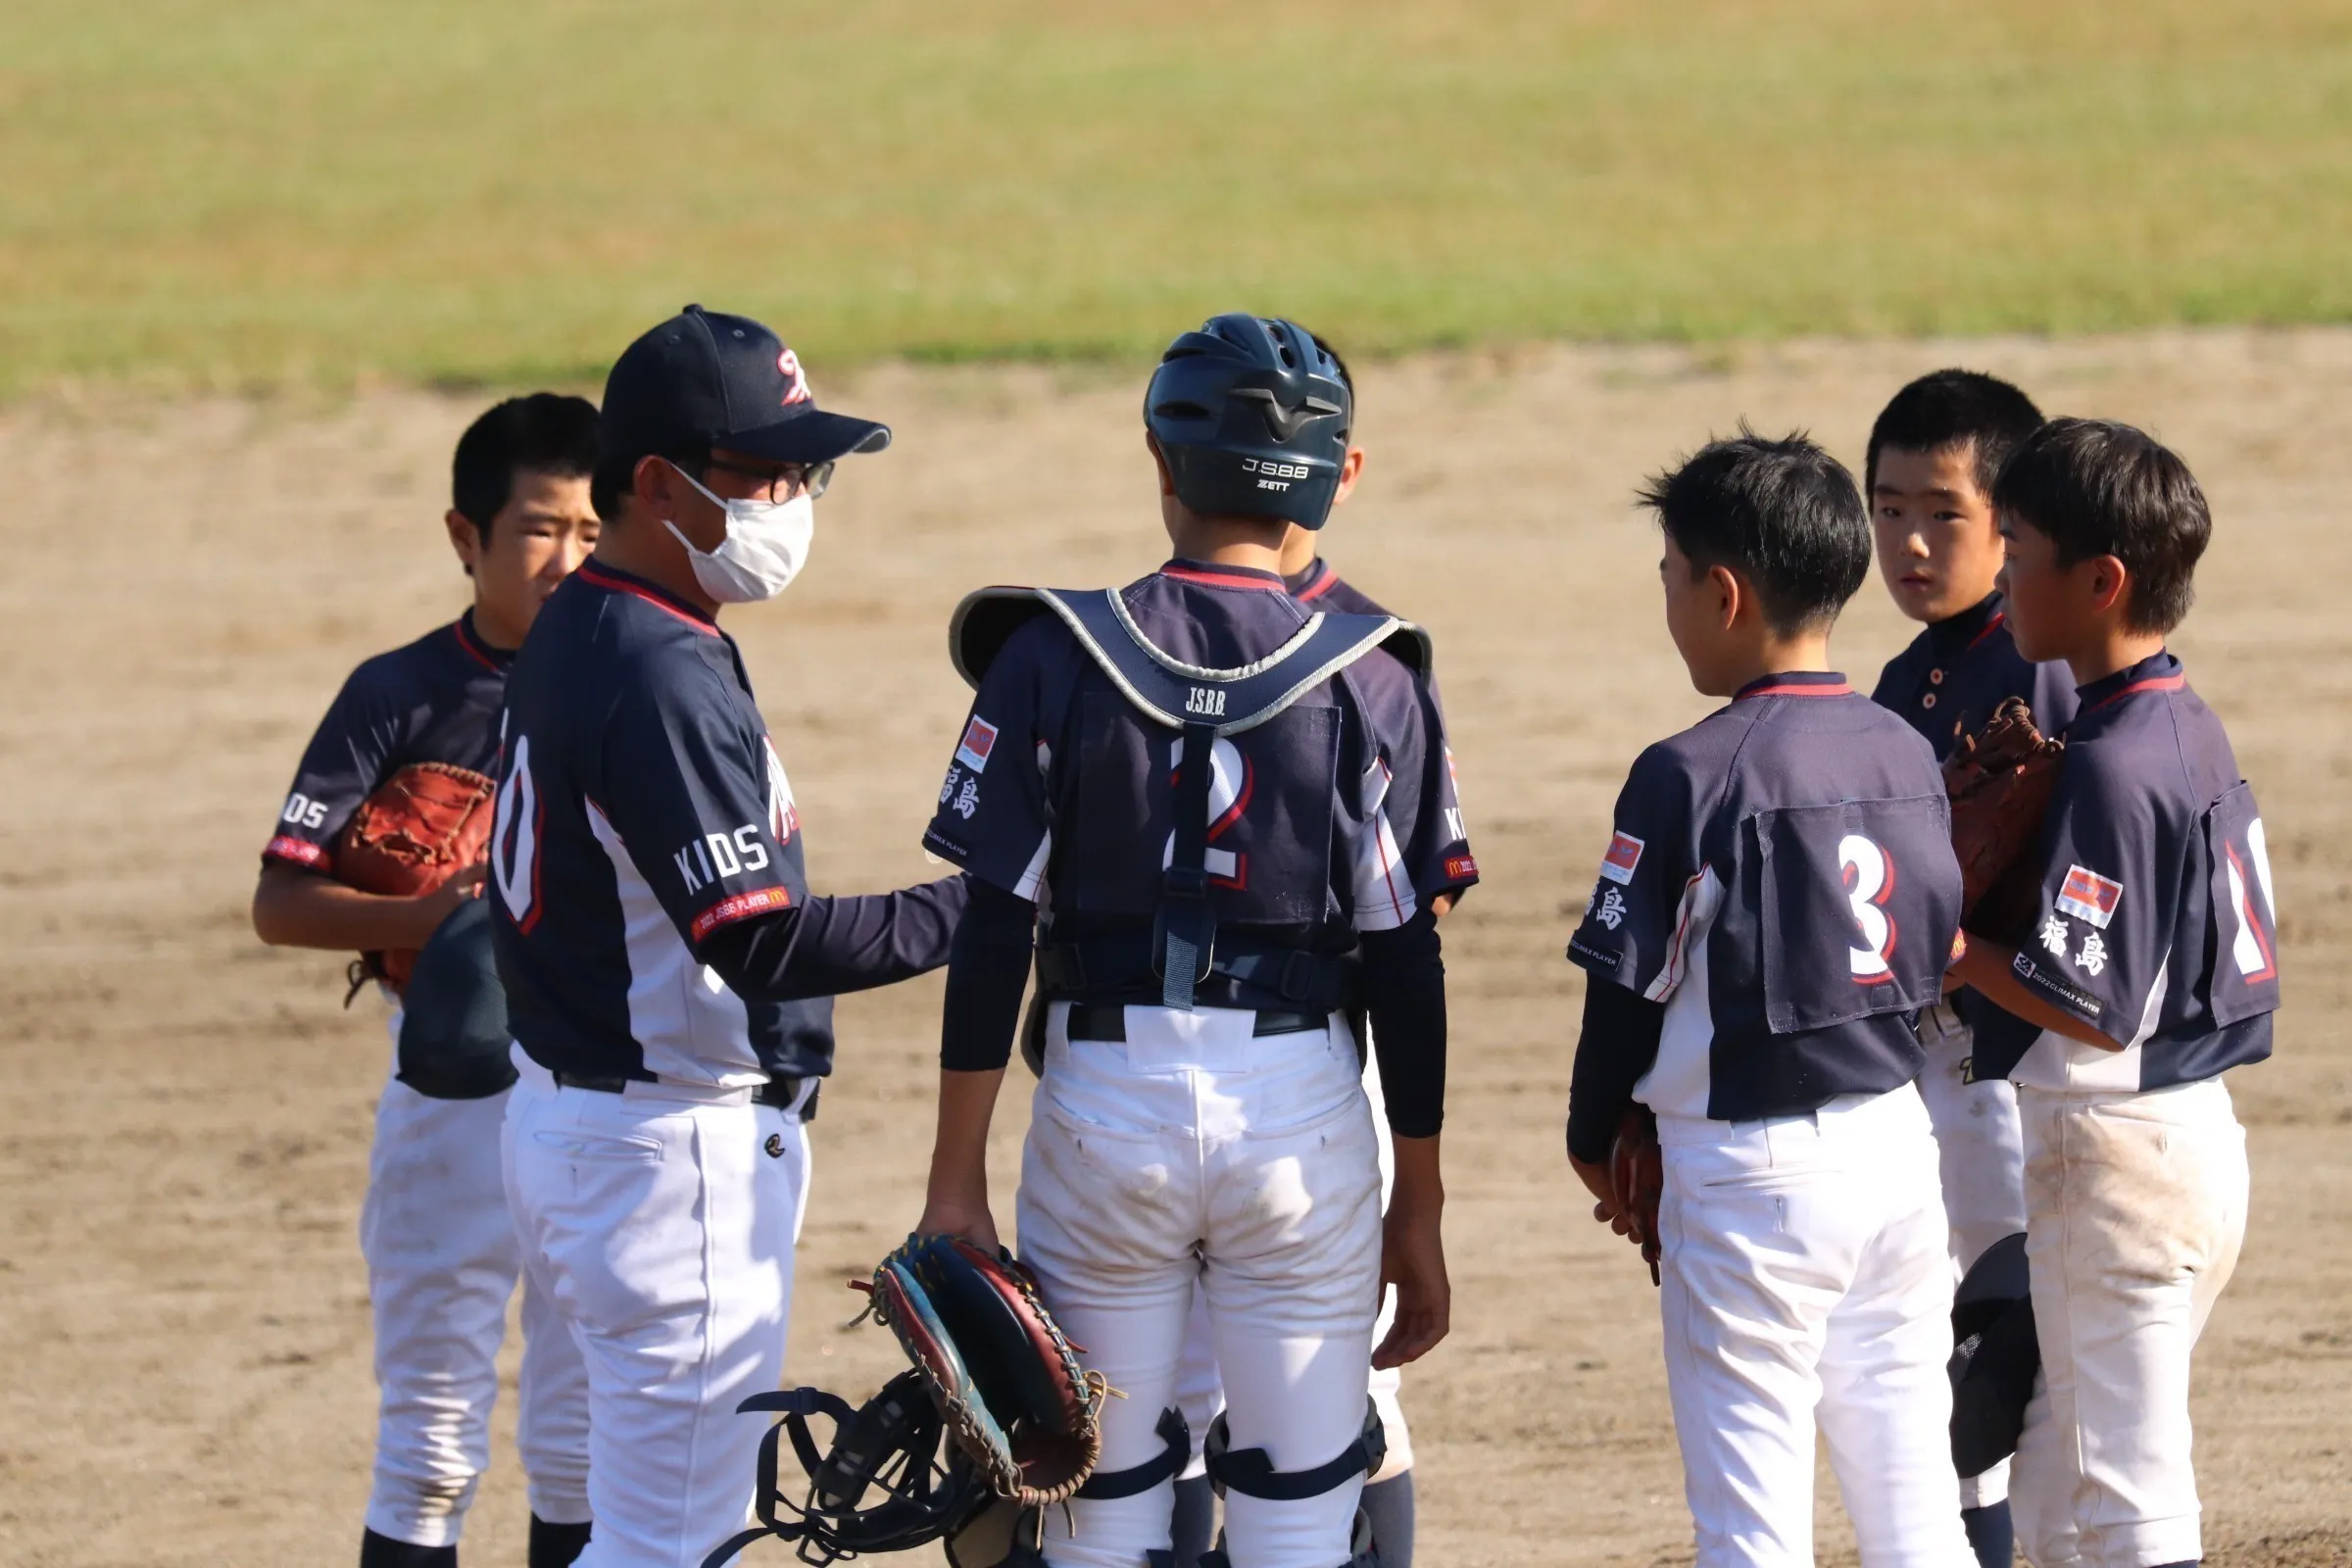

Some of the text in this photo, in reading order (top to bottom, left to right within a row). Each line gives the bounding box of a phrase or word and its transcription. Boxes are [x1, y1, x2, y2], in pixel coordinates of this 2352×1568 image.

[1256, 478, 1291, 492] ZETT
[673, 823, 769, 897] KIDS
[736, 892, 770, 911] PLAYER
[1838, 835, 1895, 982] 3
[2039, 915, 2109, 976] 福島
[1592, 951, 1617, 966] PLAYER
[2075, 996, 2101, 1015] PLAYER
